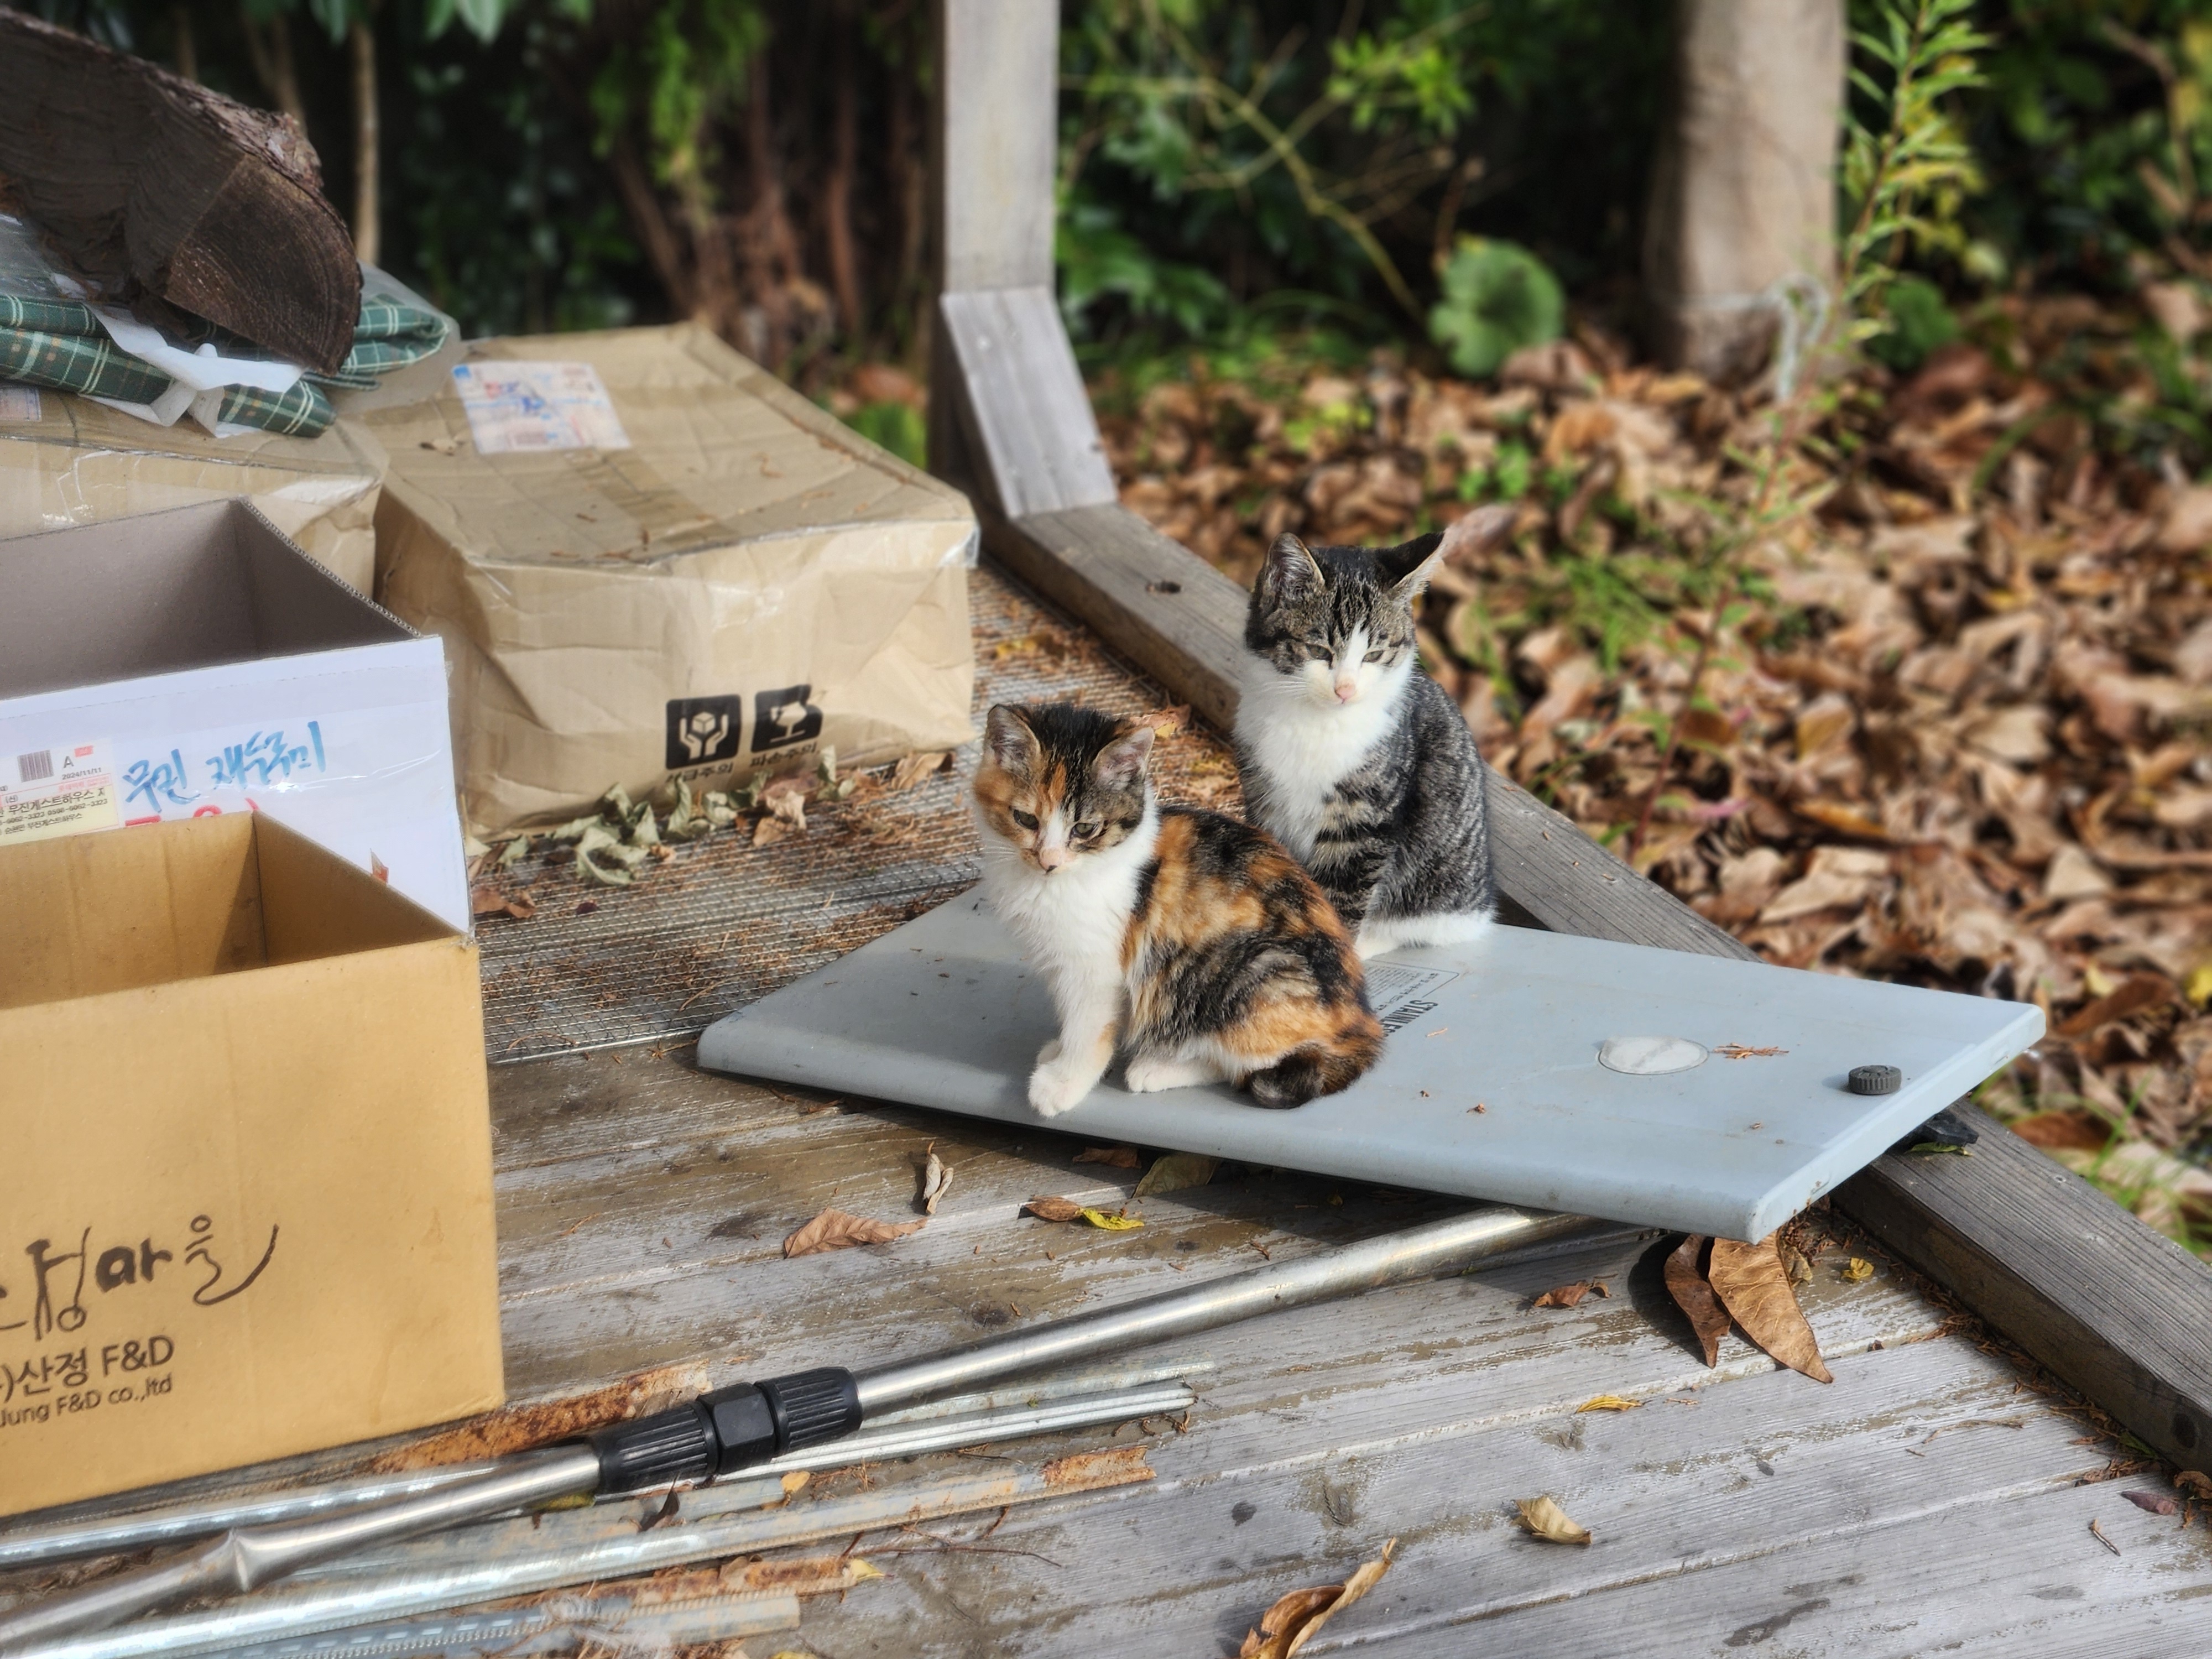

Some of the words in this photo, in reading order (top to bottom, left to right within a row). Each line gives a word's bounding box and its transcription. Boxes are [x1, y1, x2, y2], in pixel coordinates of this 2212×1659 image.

[63, 755, 75, 769] A
[62, 767, 102, 780] 2024/11/11
[102, 1335, 175, 1378] F&D
[56, 1390, 101, 1417] F&D
